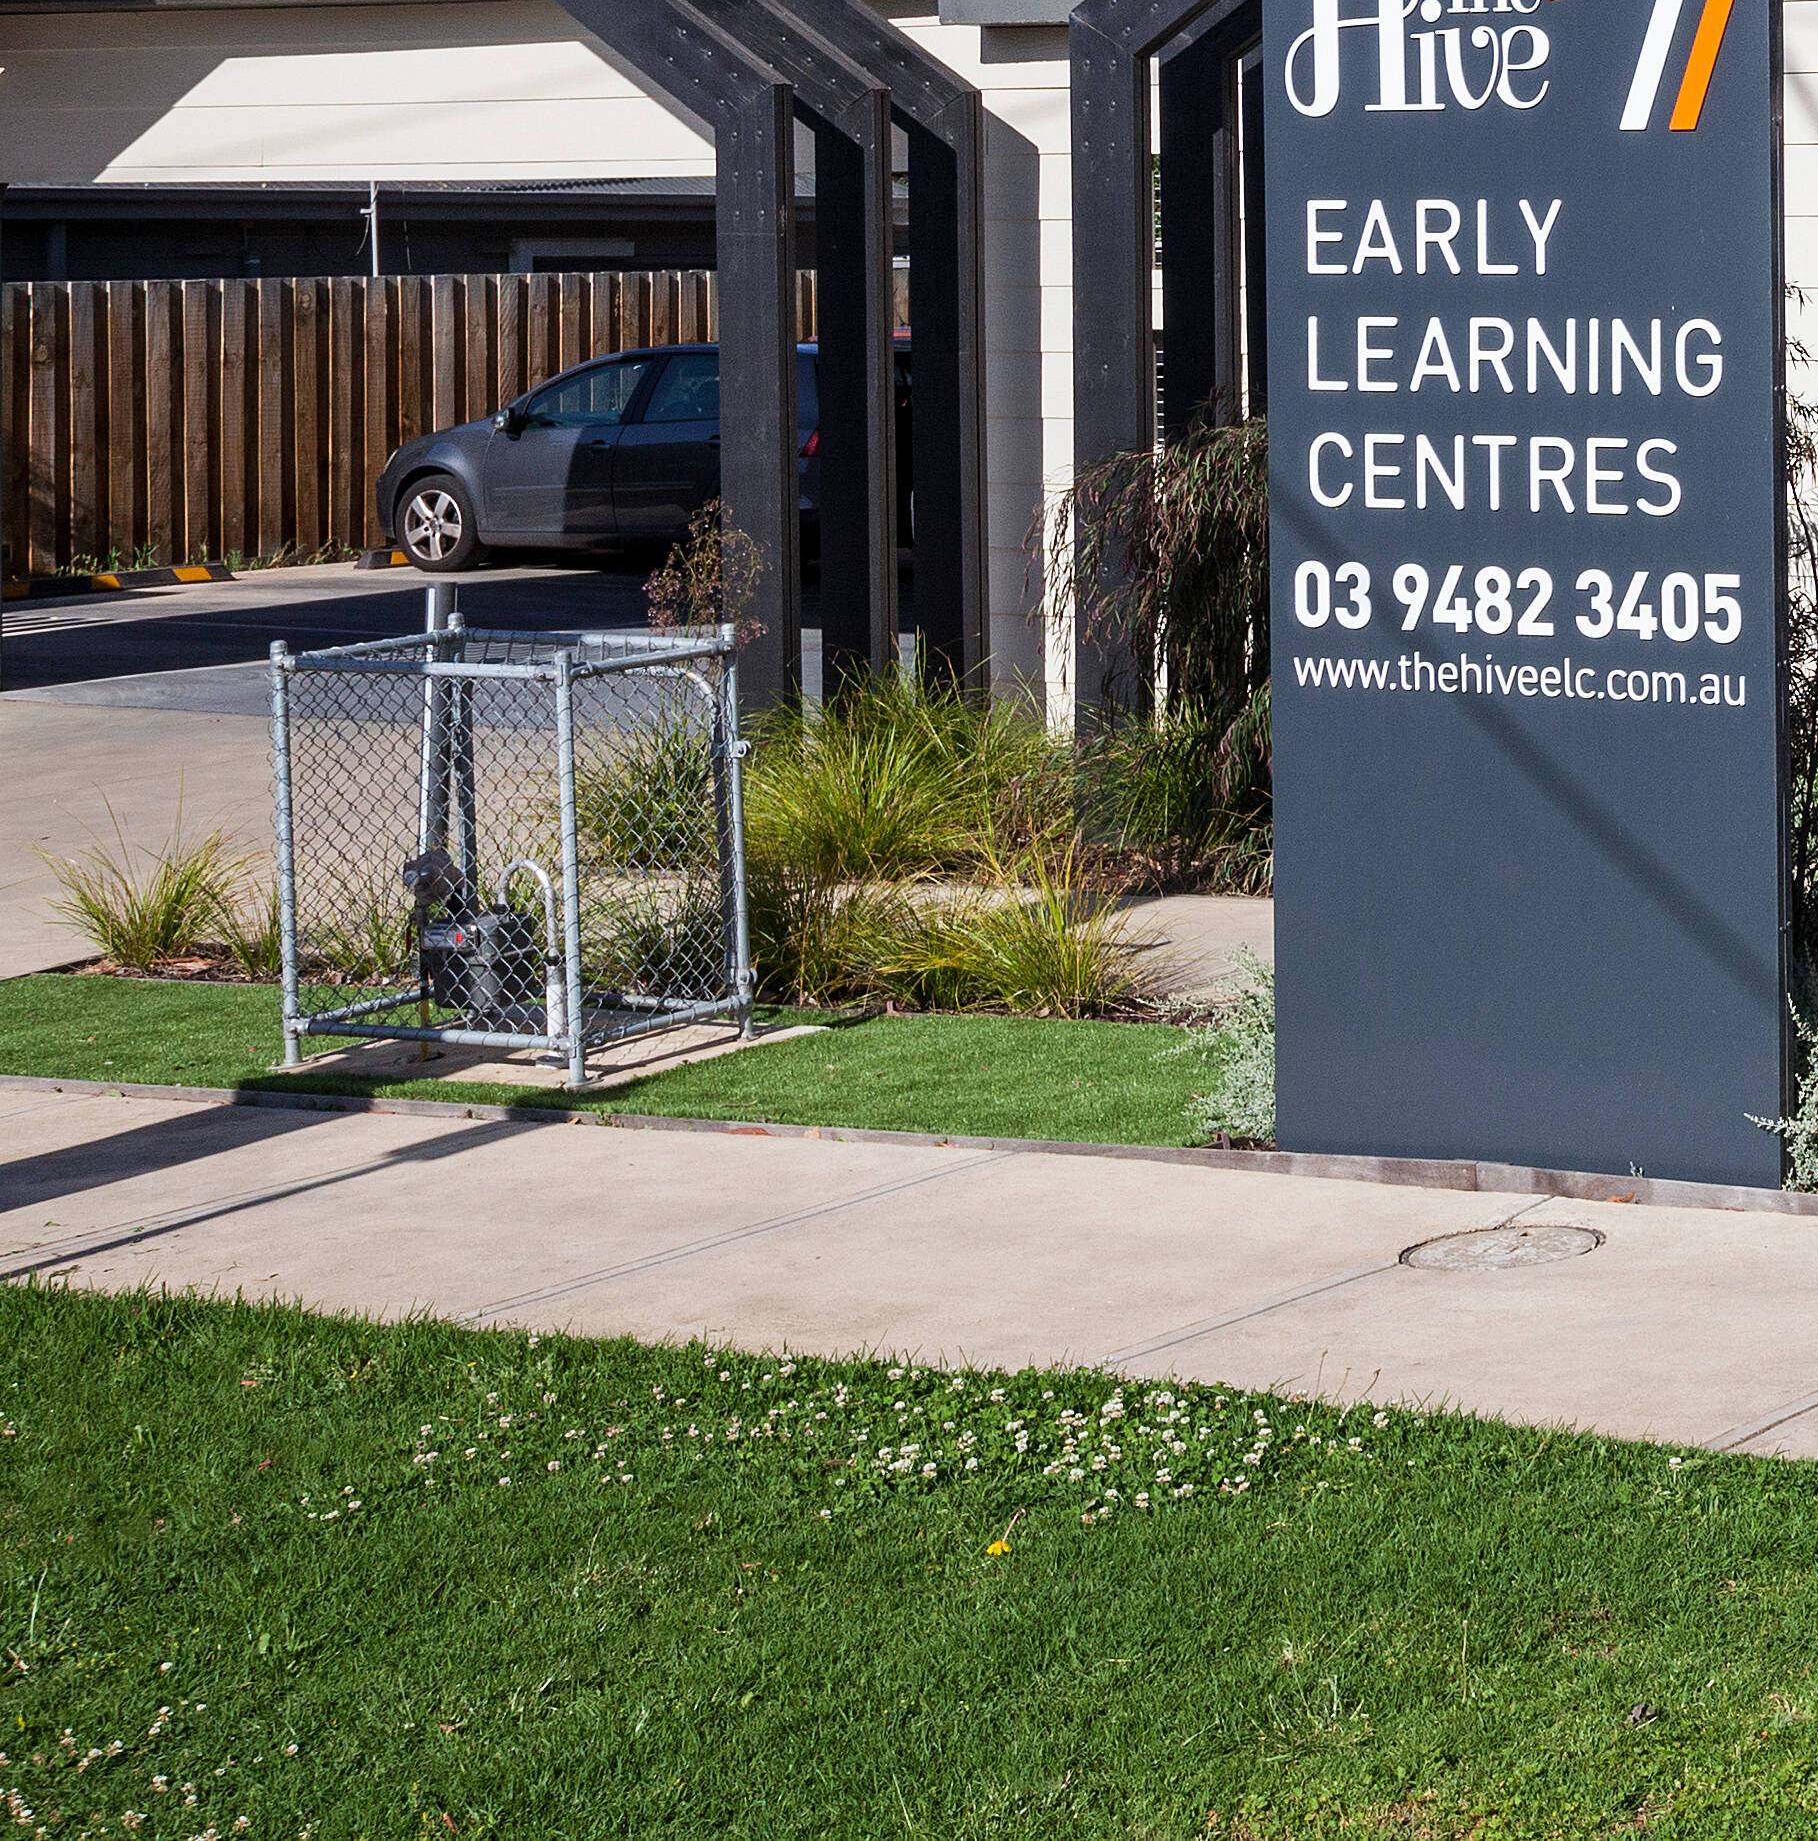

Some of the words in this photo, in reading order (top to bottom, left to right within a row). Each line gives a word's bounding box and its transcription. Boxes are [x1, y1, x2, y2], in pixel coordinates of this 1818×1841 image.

[1306, 198, 1562, 276] EARLY
[1307, 315, 1724, 397] LEARNING
[1309, 431, 1682, 516] CENTRES
[1294, 560, 1372, 630] 03
[1392, 563, 1555, 637] 9482
[1575, 568, 1742, 644] 3405
[1293, 651, 1747, 707] www.thehiveelc.com.au
